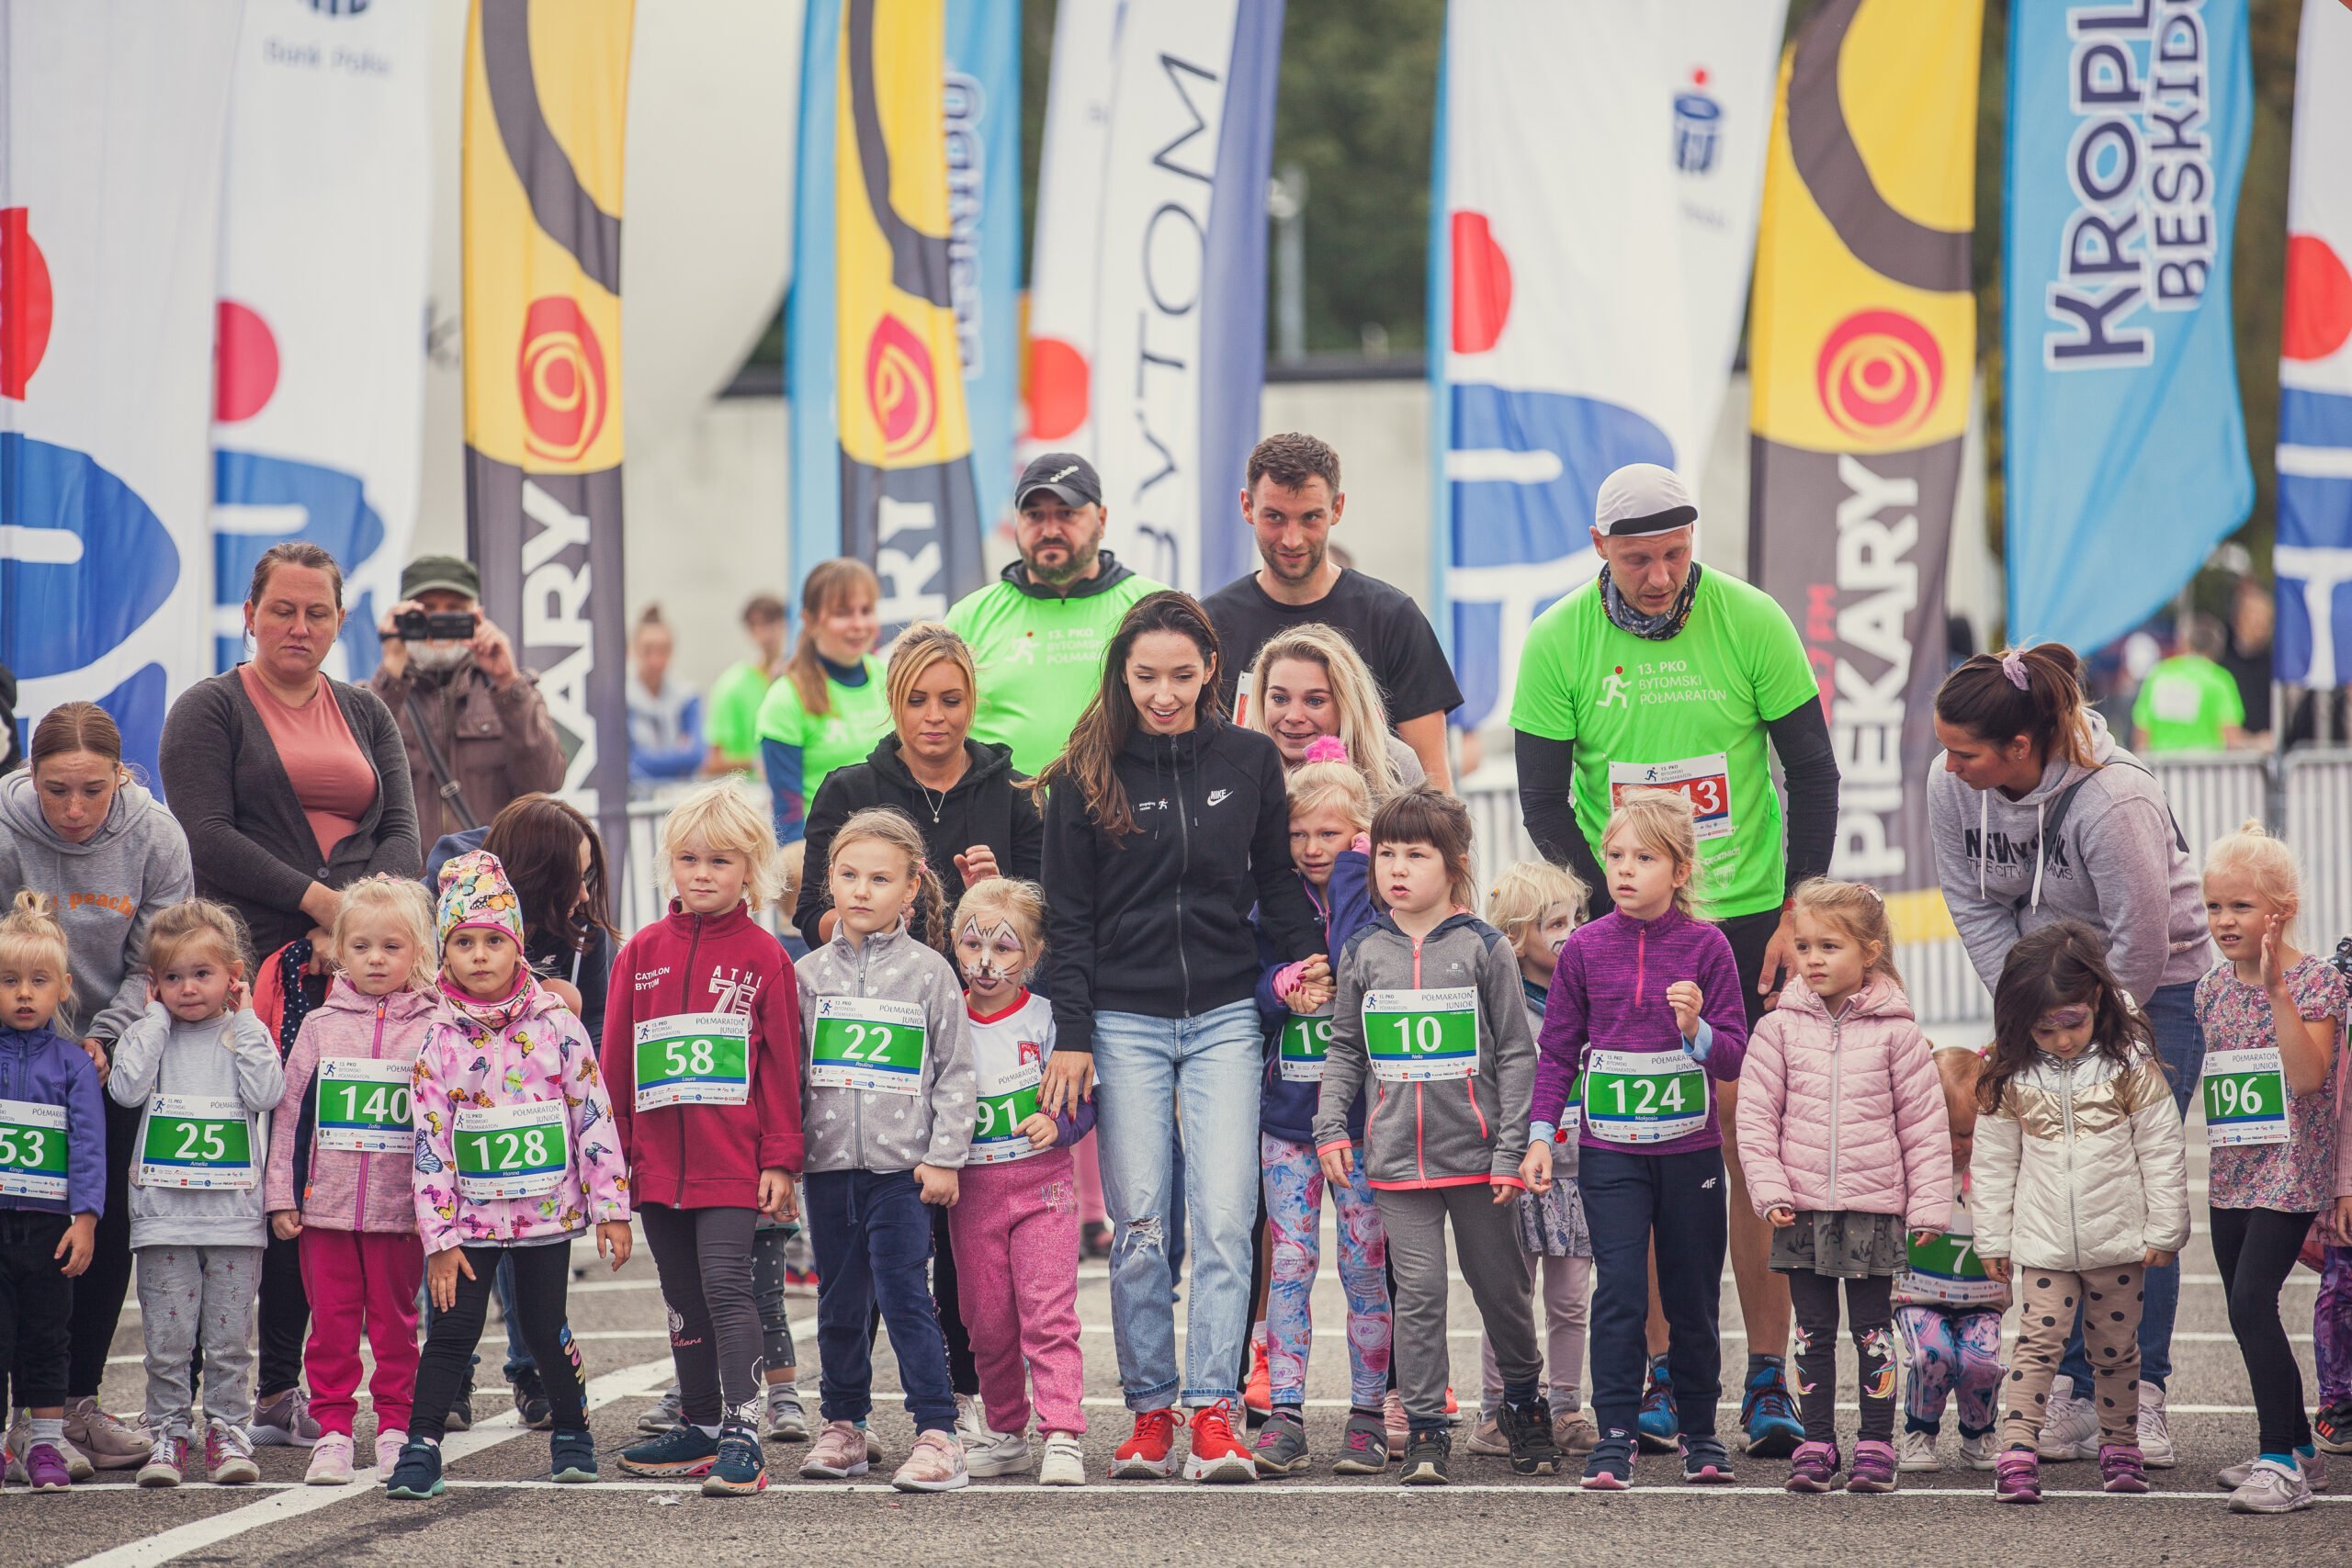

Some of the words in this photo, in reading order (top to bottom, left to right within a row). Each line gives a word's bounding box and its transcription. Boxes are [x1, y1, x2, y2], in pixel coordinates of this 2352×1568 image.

[2150, 0, 2209, 303] BESKID
[1638, 662, 1656, 675] 13.
[1659, 660, 1687, 673] PKO
[1828, 453, 1919, 879] PIEKARY
[1639, 675, 1702, 690] BYTOMSKI
[1640, 689, 1726, 705] PÓŁMARATON
[1210, 789, 1227, 800] NIKE
[635, 966, 671, 981] CATHLON
[635, 978, 660, 991] BYTOM
[1421, 992, 1473, 1000] PÓŁMARATON
[1446, 1000, 1474, 1010] JUNIOR
[695, 1017, 744, 1026] PÓŁMARATON
[720, 1026, 744, 1035] JUNIOR
[1393, 1016, 1442, 1053] 10
[842, 1023, 893, 1063] 22
[664, 1039, 715, 1076] 58
[2232, 1053, 2278, 1063] PÓŁMARATON
[2253, 1062, 2278, 1072] JUNIOR
[998, 1066, 1036, 1085] PÓŁMARATON
[1019, 1075, 1039, 1088] JUNIOR
[1608, 1077, 1686, 1114] 124
[2211, 1077, 2263, 1116] 196
[339, 1085, 413, 1124] 140
[513, 1105, 560, 1117] PÓŁMARATON
[536, 1113, 560, 1123] JUNIOR
[976, 1097, 1018, 1136] 91
[0, 1127, 44, 1168] 53
[175, 1122, 225, 1160] 25
[470, 1129, 548, 1171] 128
[1701, 1177, 1717, 1190] 4F
[1950, 1238, 1973, 1275] 7
